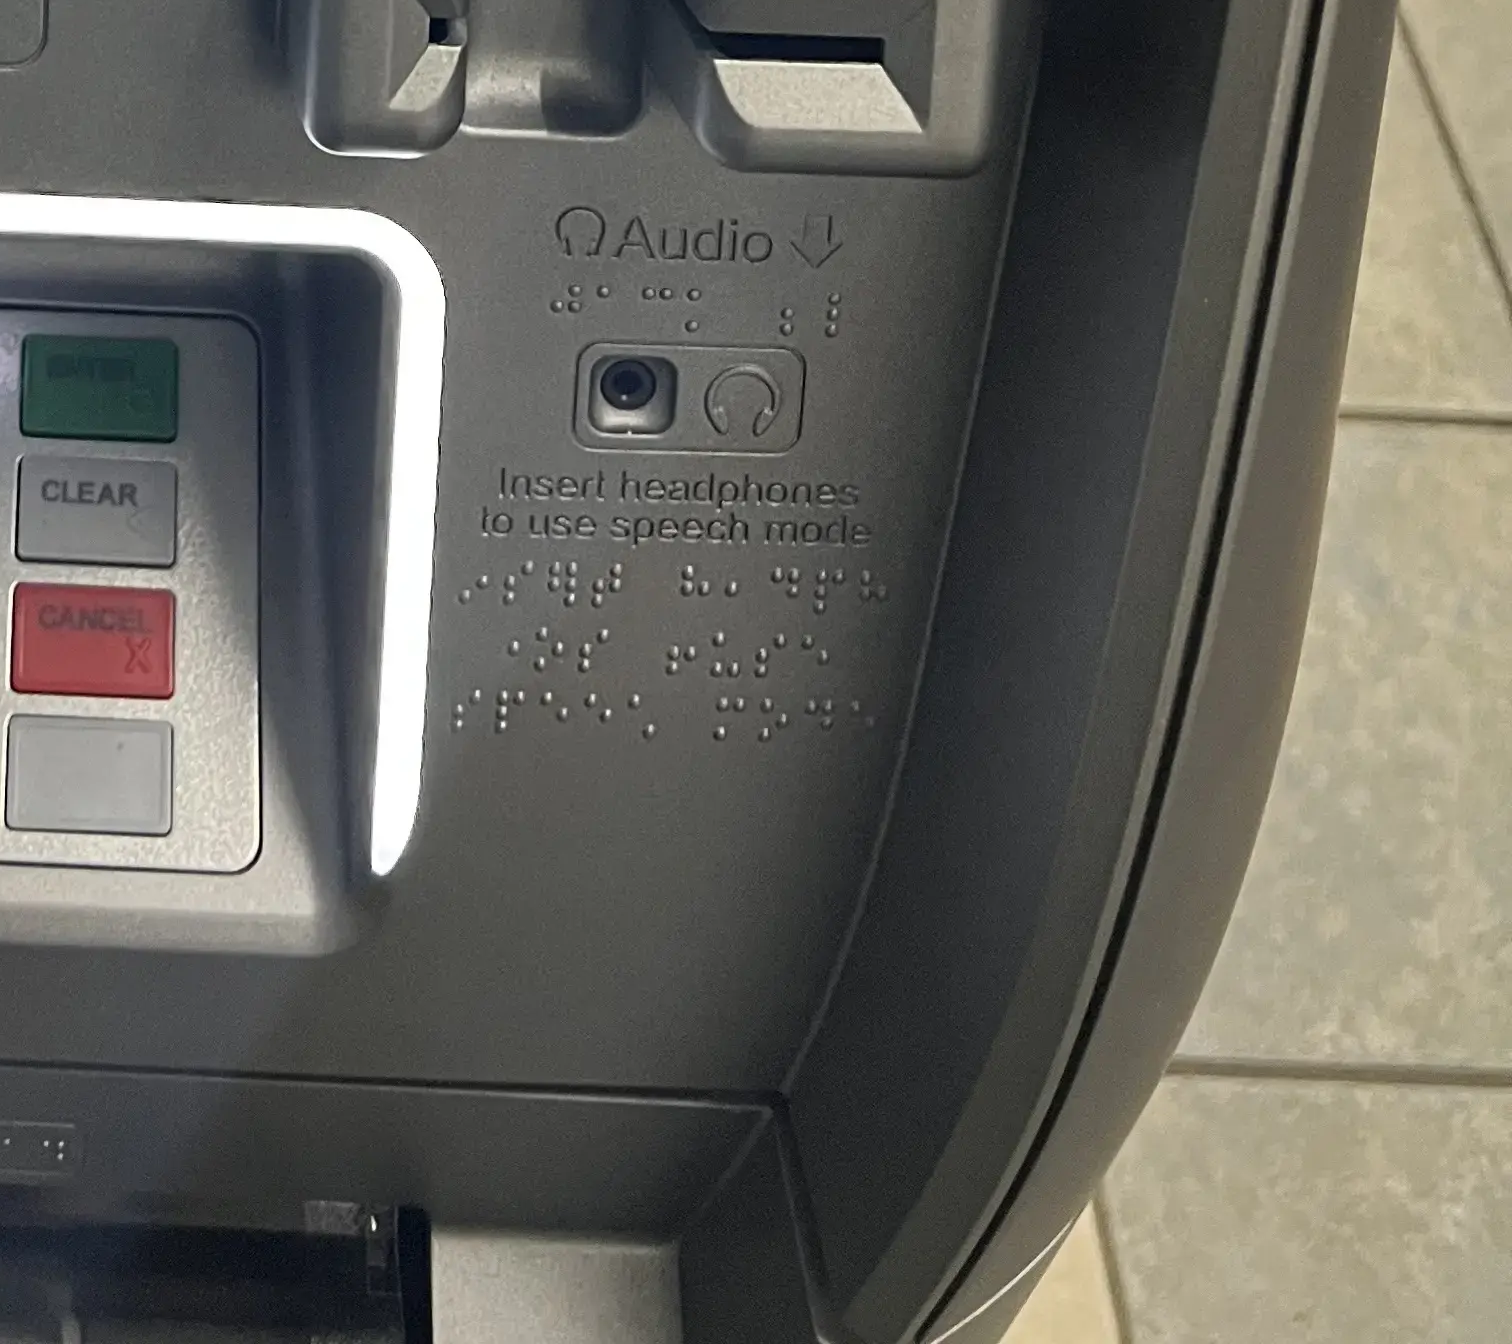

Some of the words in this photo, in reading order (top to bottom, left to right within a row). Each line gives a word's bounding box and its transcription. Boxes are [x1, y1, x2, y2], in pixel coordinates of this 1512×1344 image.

[612, 216, 773, 264] Audio
[41, 479, 139, 508] CLEAR
[498, 467, 606, 501] Insert
[620, 471, 860, 512] headphones
[481, 505, 514, 538] to
[529, 513, 597, 539] use
[610, 512, 750, 549] speech
[765, 514, 874, 547] mode
[37, 604, 152, 634] CANCEL
